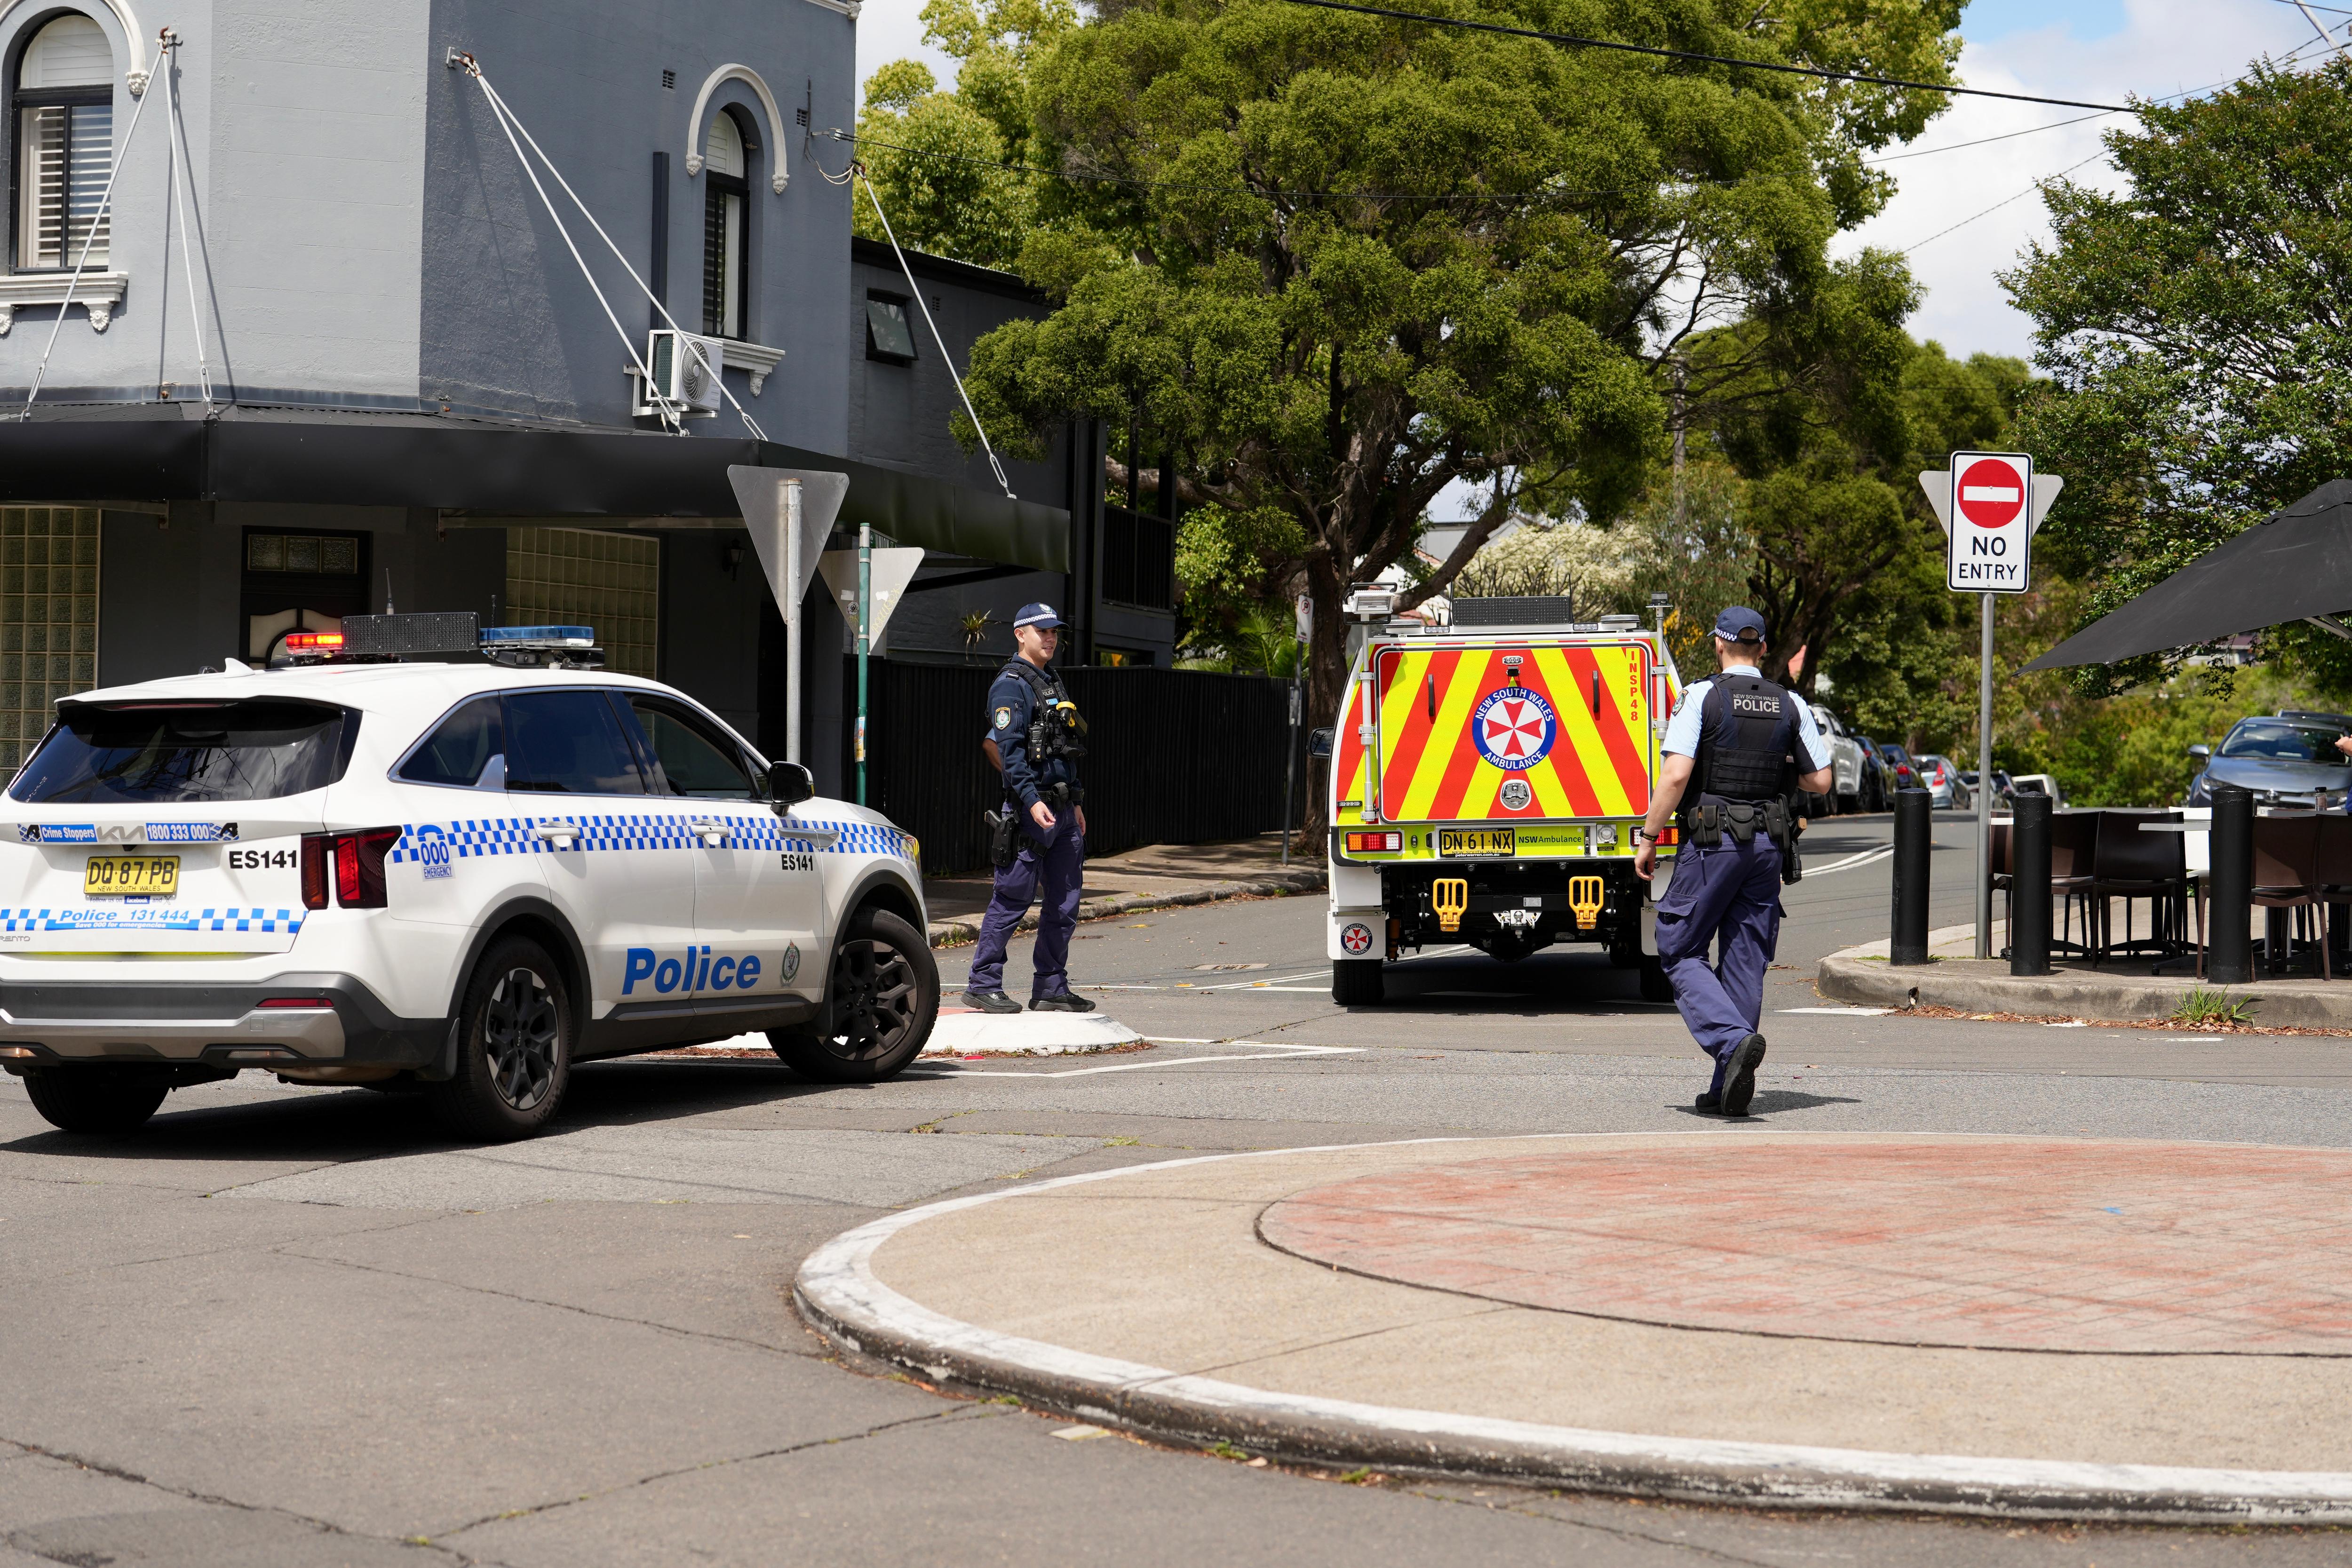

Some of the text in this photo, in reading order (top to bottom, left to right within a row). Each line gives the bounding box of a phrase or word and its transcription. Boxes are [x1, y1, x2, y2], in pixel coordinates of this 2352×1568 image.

[875, 534, 889, 548] UNION
[1972, 536, 2006, 556] NO
[1959, 563, 2018, 580] ENTRY
[1475, 688, 1554, 722] NEW SOUTH WALES
[1733, 699, 1780, 713] POLICE
[1484, 750, 1544, 769] AMBULANCE
[42, 827, 95, 841] Crime Stoppers
[147, 824, 209, 840] 1800 333 000
[1444, 833, 1511, 850] DN 61 NX
[229, 850, 296, 869] ES141
[421, 841, 449, 866] 000
[781, 854, 813, 871] ES141
[119, 861, 144, 884] 87
[149, 861, 175, 884] PB
[424, 866, 452, 878] EMERGENCY
[59, 909, 117, 922] Police
[1362, 925, 1371, 937] WALES
[621, 945, 761, 995] Police
